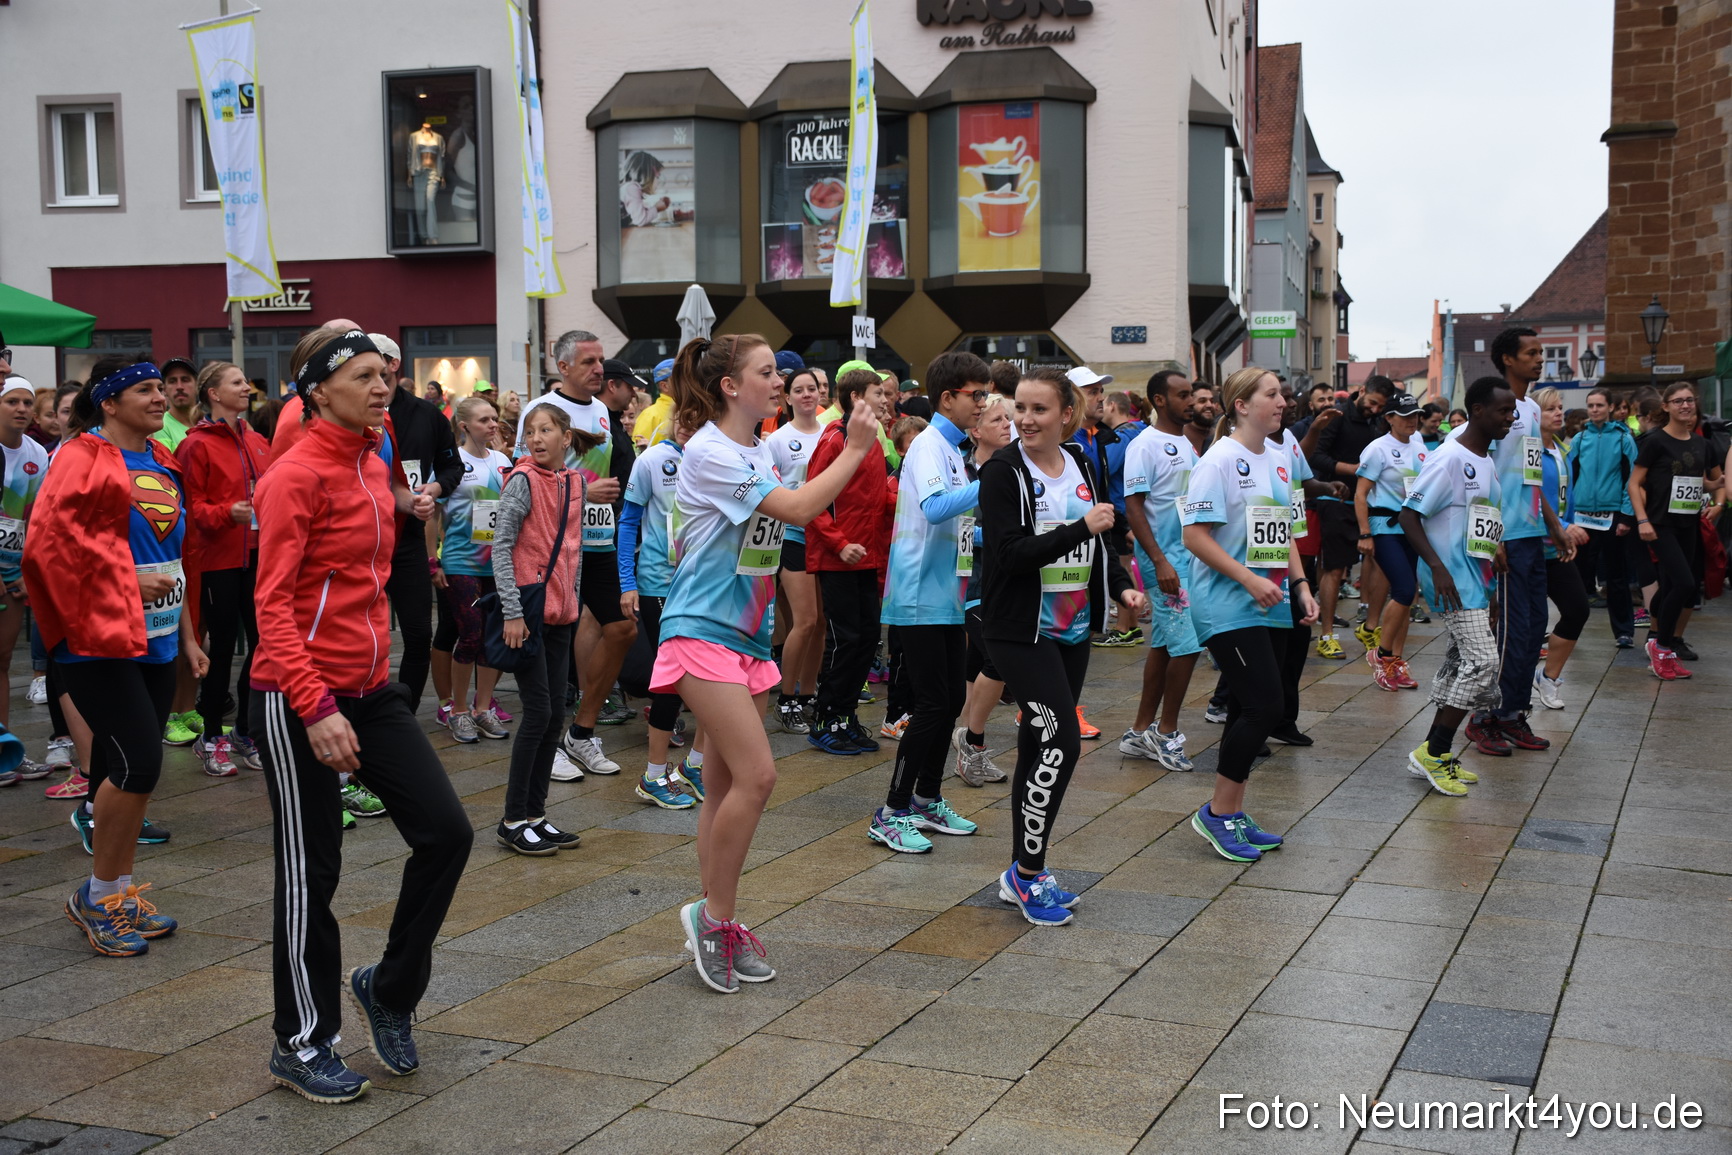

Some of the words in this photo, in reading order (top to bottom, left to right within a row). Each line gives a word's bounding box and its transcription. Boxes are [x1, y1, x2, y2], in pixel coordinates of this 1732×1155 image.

[940, 36, 974, 48] am
[981, 24, 1075, 46] Rathaus
[797, 122, 815, 134] 100
[818, 118, 850, 133] Jahre
[791, 135, 842, 161] RACKL
[1255, 316, 1286, 325] GEERS
[855, 325, 870, 339] WC
[1528, 449, 1542, 467] 52
[1184, 501, 1213, 512] BOCK
[587, 530, 604, 538] Ralph
[1475, 518, 1503, 542] 5238
[1062, 571, 1079, 581] Anna
[153, 614, 174, 627] Gisela
[1021, 748, 1064, 855] adidas
